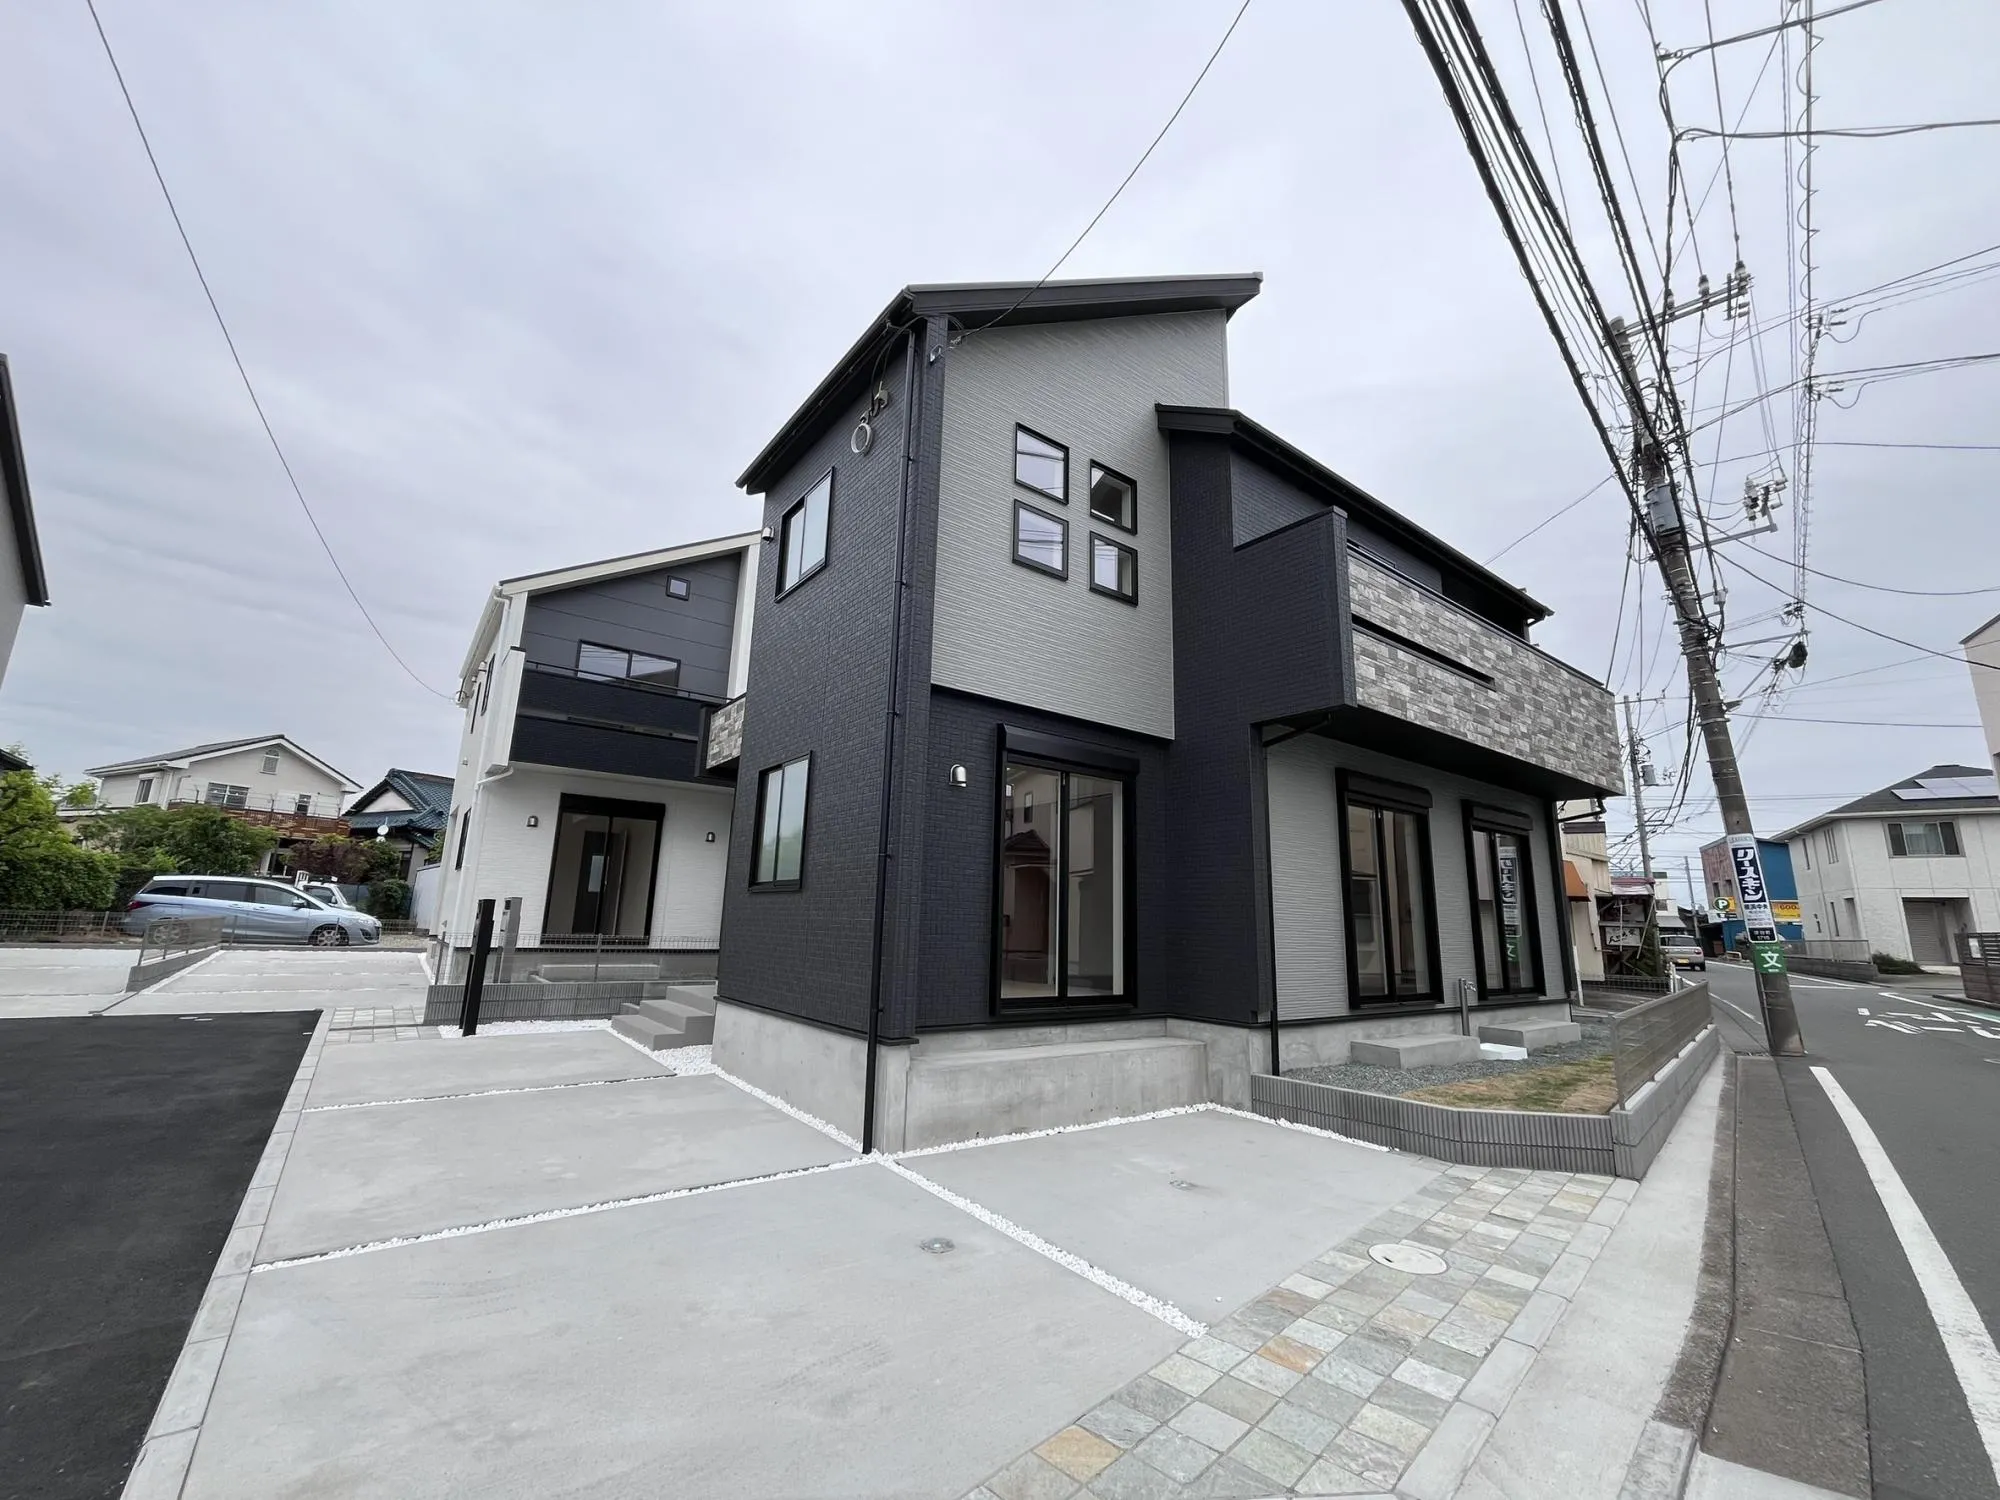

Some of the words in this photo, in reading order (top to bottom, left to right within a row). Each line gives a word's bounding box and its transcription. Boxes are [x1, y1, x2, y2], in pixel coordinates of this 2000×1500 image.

[1737, 849, 1763, 901] リースキン
[1718, 899, 1728, 909] P
[1760, 950, 1783, 968] 文
